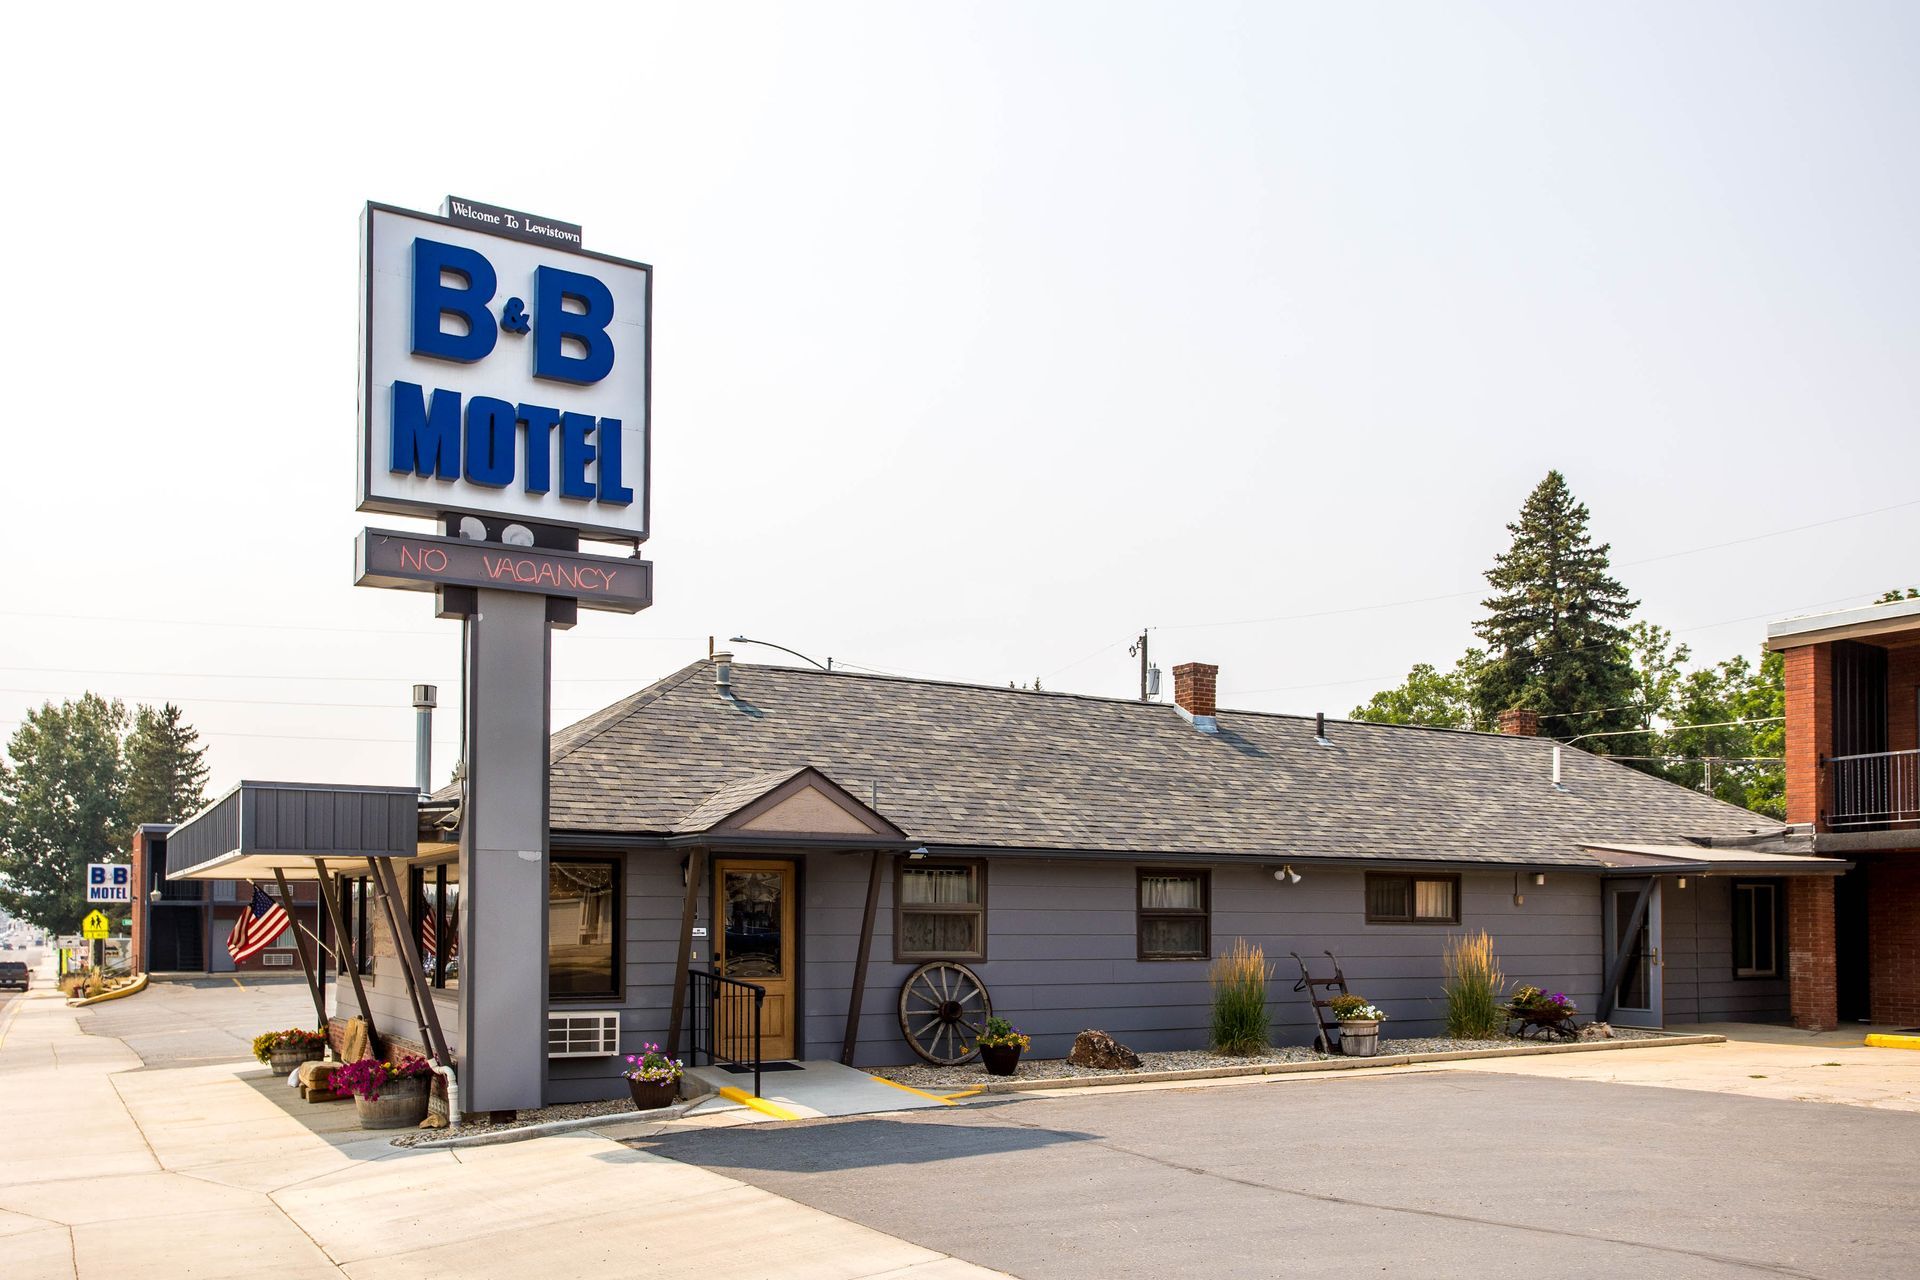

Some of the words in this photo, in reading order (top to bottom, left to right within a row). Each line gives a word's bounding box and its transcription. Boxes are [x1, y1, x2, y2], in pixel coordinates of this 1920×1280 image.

[452, 201, 500, 224] Welcome
[504, 214, 519, 229] To
[525, 219, 580, 243] Lewistown
[389, 380, 634, 508] MOTEL
[401, 545, 447, 572] NO
[90, 887, 127, 899] MOTEL
